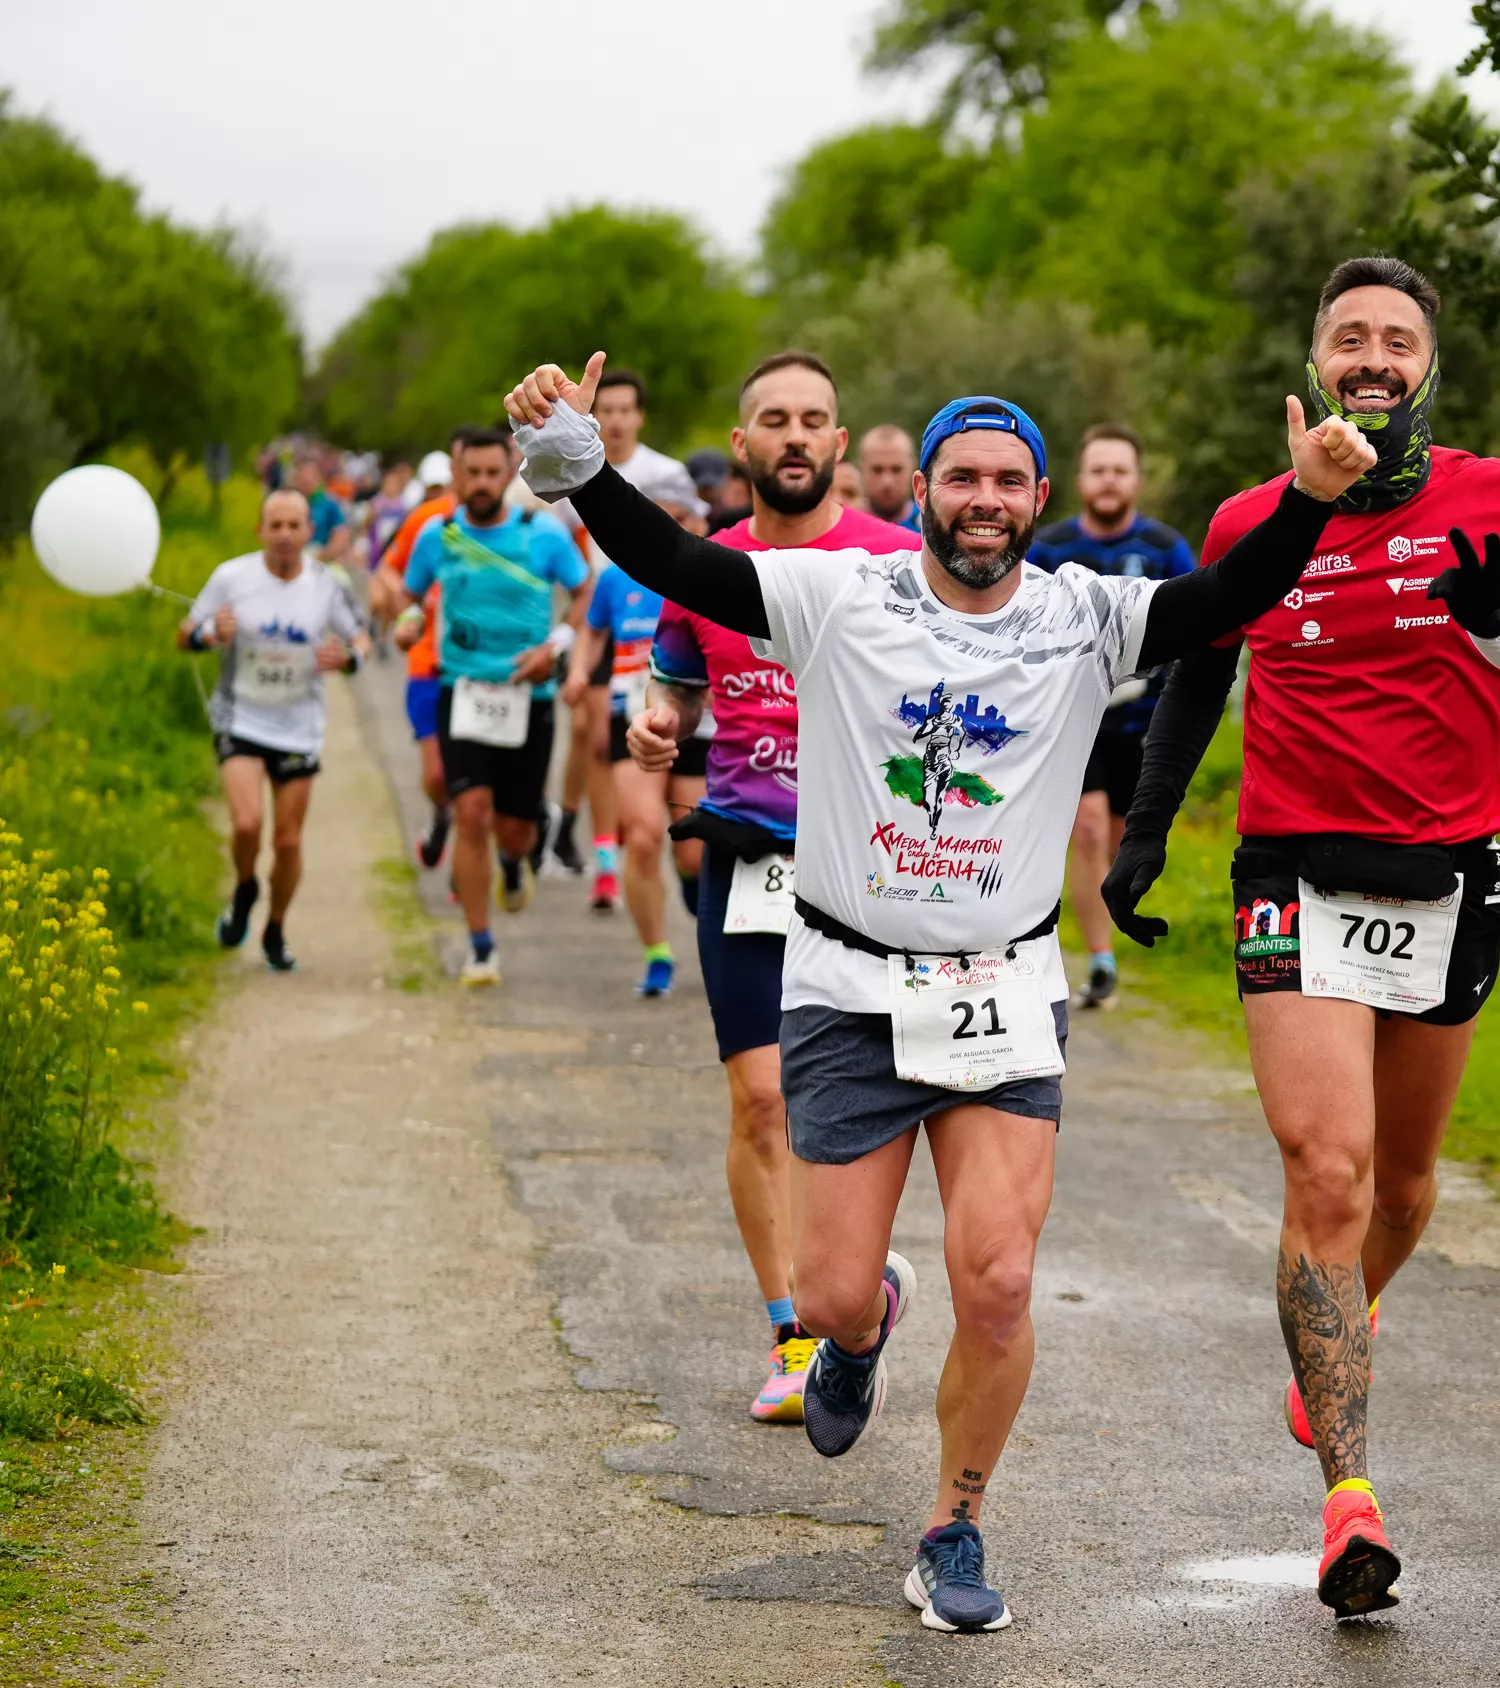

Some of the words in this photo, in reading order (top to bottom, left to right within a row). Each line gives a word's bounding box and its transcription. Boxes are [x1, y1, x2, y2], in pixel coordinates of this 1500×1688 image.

[1412, 536, 1447, 545] UNIVERSIDAD
[1394, 614, 1450, 631] hymcor
[896, 851, 982, 882] LUCENA
[765, 864, 795, 896] 8
[1339, 913, 1416, 960] 702
[1240, 939, 1293, 955] HABITANTES
[1369, 965, 1386, 974] PÉREZ
[1386, 970, 1410, 978] MURILLO
[950, 997, 1008, 1040] 21
[963, 1050, 991, 1058] ALGUACIL
[991, 1046, 1014, 1055] GARCÍA
